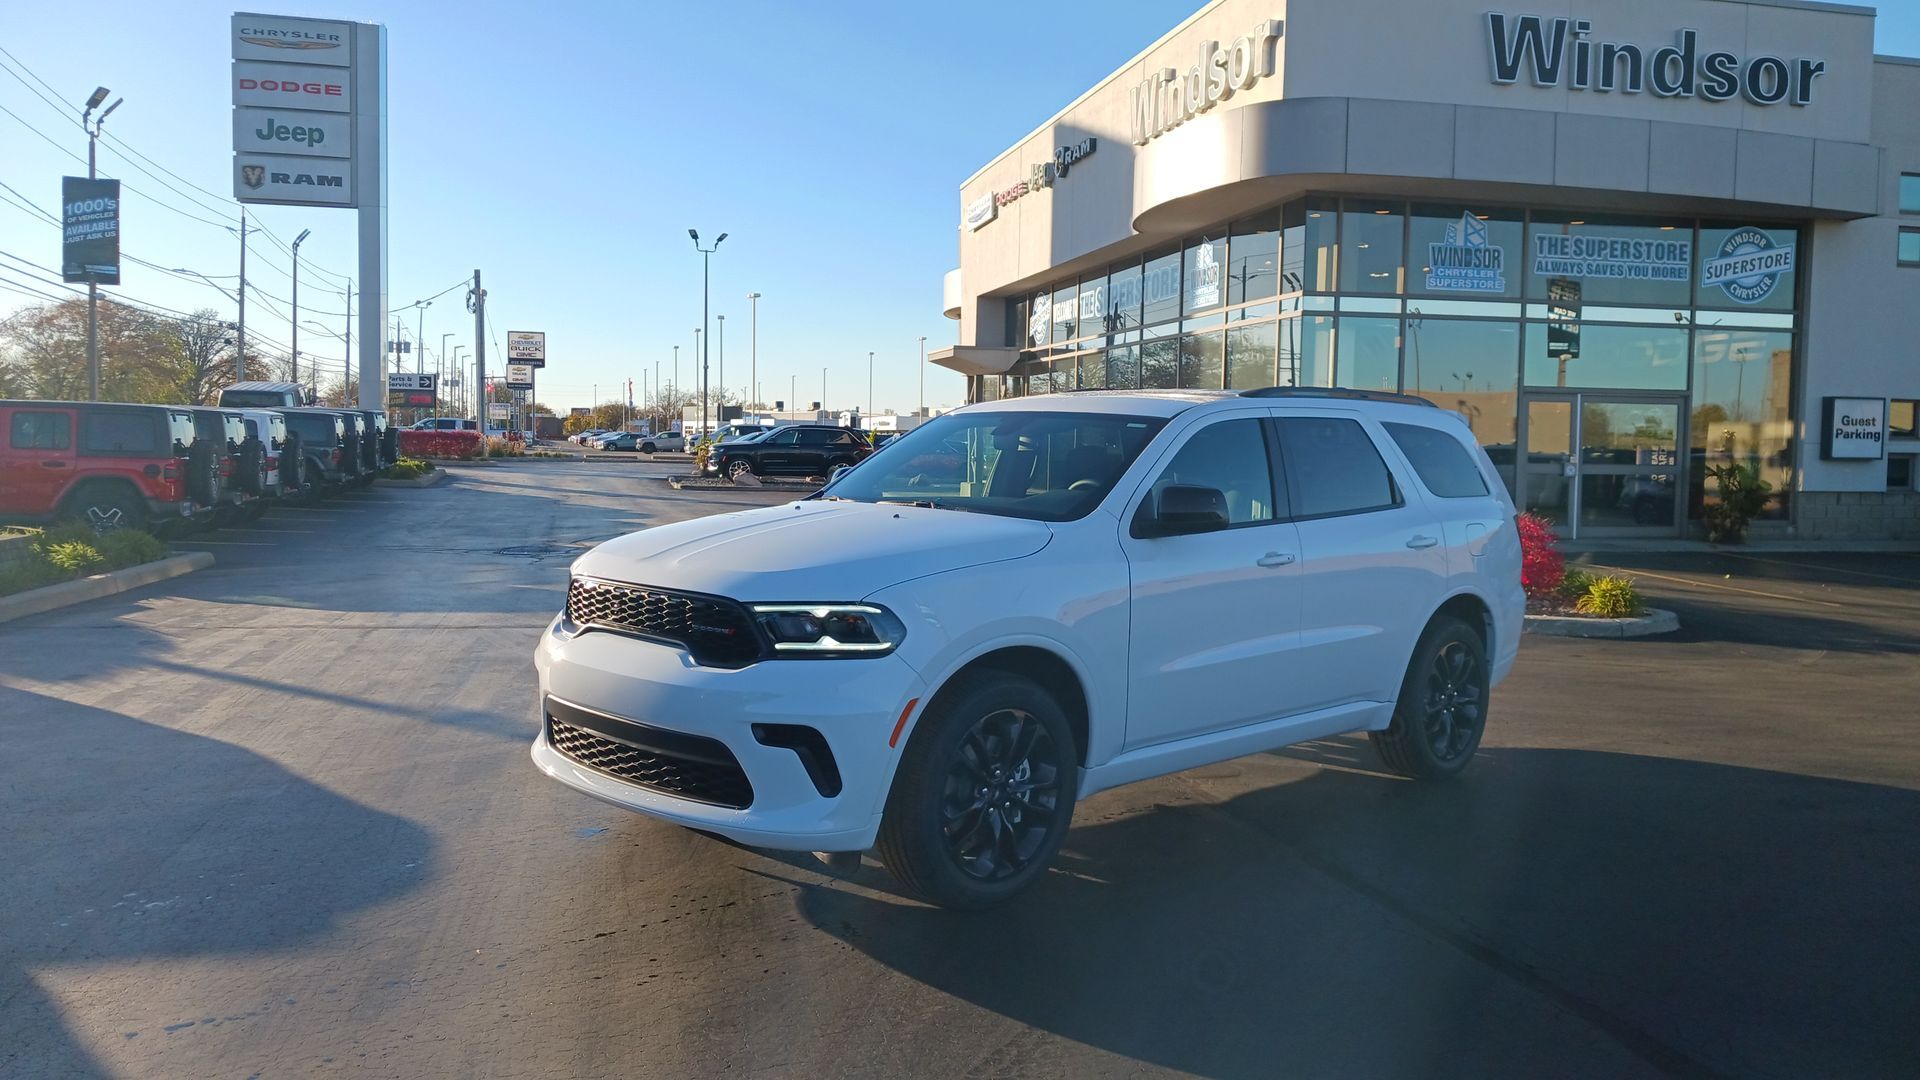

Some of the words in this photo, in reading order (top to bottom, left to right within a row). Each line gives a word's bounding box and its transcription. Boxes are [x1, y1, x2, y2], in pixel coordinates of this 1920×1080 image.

[240, 28, 341, 42] CHRYSLER
[1486, 12, 1825, 106] Windsor
[239, 78, 342, 96] DODGE
[1130, 19, 1284, 146] Windsor
[255, 118, 325, 147] Jeep
[1064, 138, 1096, 166] RAM
[271, 172, 342, 187] RAM
[995, 181, 1029, 206] DODGE
[65, 198, 116, 215] 1000's
[79, 212, 114, 221] VEHICLES
[65, 221, 117, 236] AVAILABLE
[65, 235, 84, 243] JUST
[86, 232, 103, 240] ASK
[105, 230, 116, 238] US
[1536, 235, 1570, 256] THE
[1572, 236, 1689, 262] SUPERSTORE
[1725, 232, 1767, 253] WINDSOR
[1431, 246, 1501, 269] WINDSOR
[1706, 251, 1791, 280] SUPERSTORE
[1438, 268, 1495, 278] CHRYSLER
[1536, 260, 1583, 274] ALWAYS
[1585, 263, 1624, 276] SAVES
[1625, 265, 1650, 277] YOU
[1651, 266, 1688, 279] MORE!
[1080, 292, 1094, 318] THE
[1095, 266, 1179, 317] SUPERSTORE
[1430, 277, 1502, 289] SUPERSTORE
[1730, 276, 1773, 299] CHRYSLER
[1841, 415, 1876, 427] Guest
[1835, 428, 1881, 442] Parking
